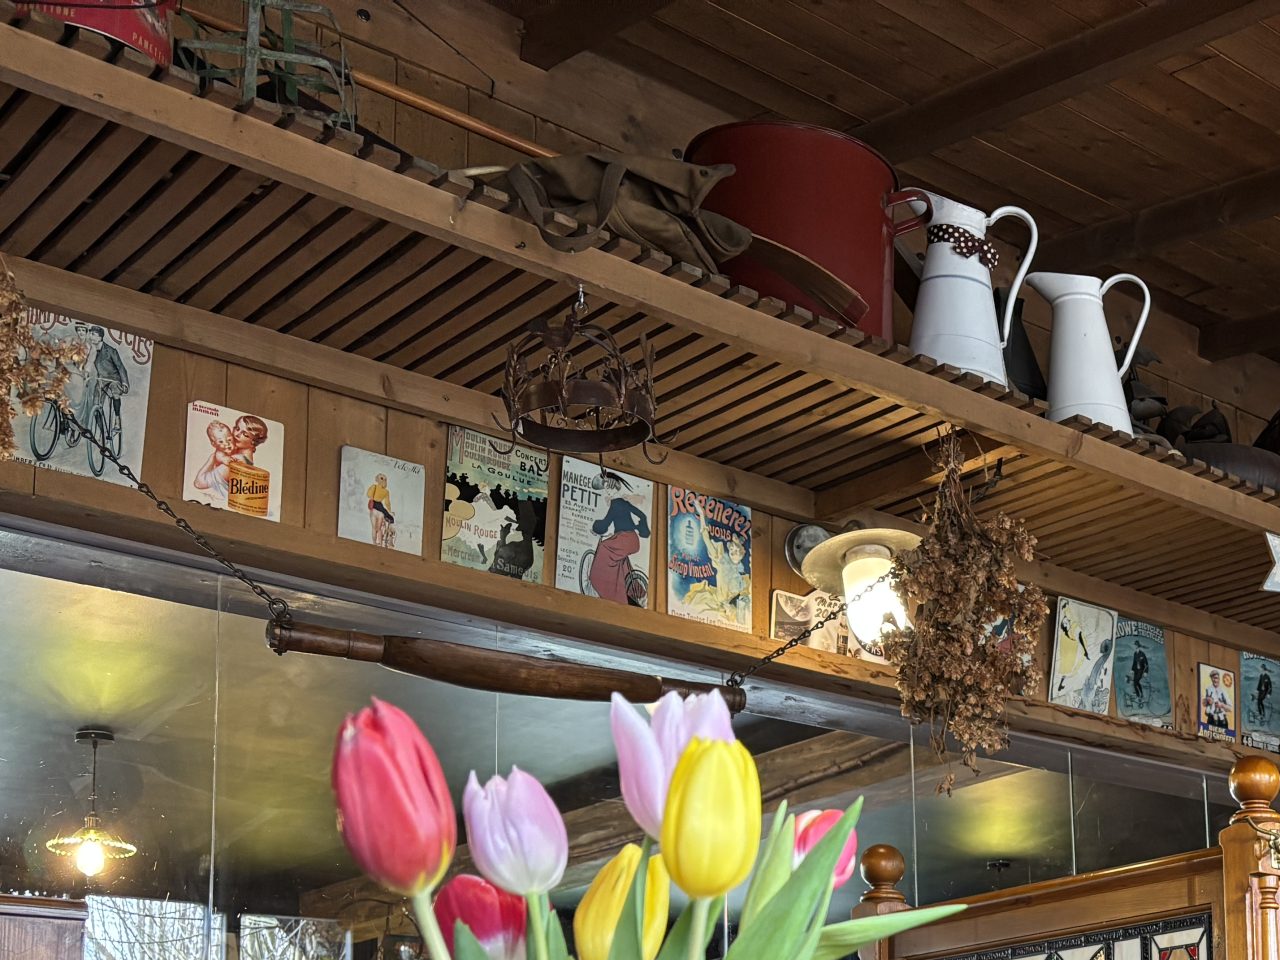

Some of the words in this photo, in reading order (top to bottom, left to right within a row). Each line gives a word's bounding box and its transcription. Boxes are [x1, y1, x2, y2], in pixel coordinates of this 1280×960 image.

[472, 462, 483, 471] LA
[487, 467, 533, 486] GOULUE
[520, 462, 543, 477] BAL
[230, 477, 269, 495] Blédine
[562, 483, 602, 508] PETIT
[473, 524, 498, 540] ROUGE
